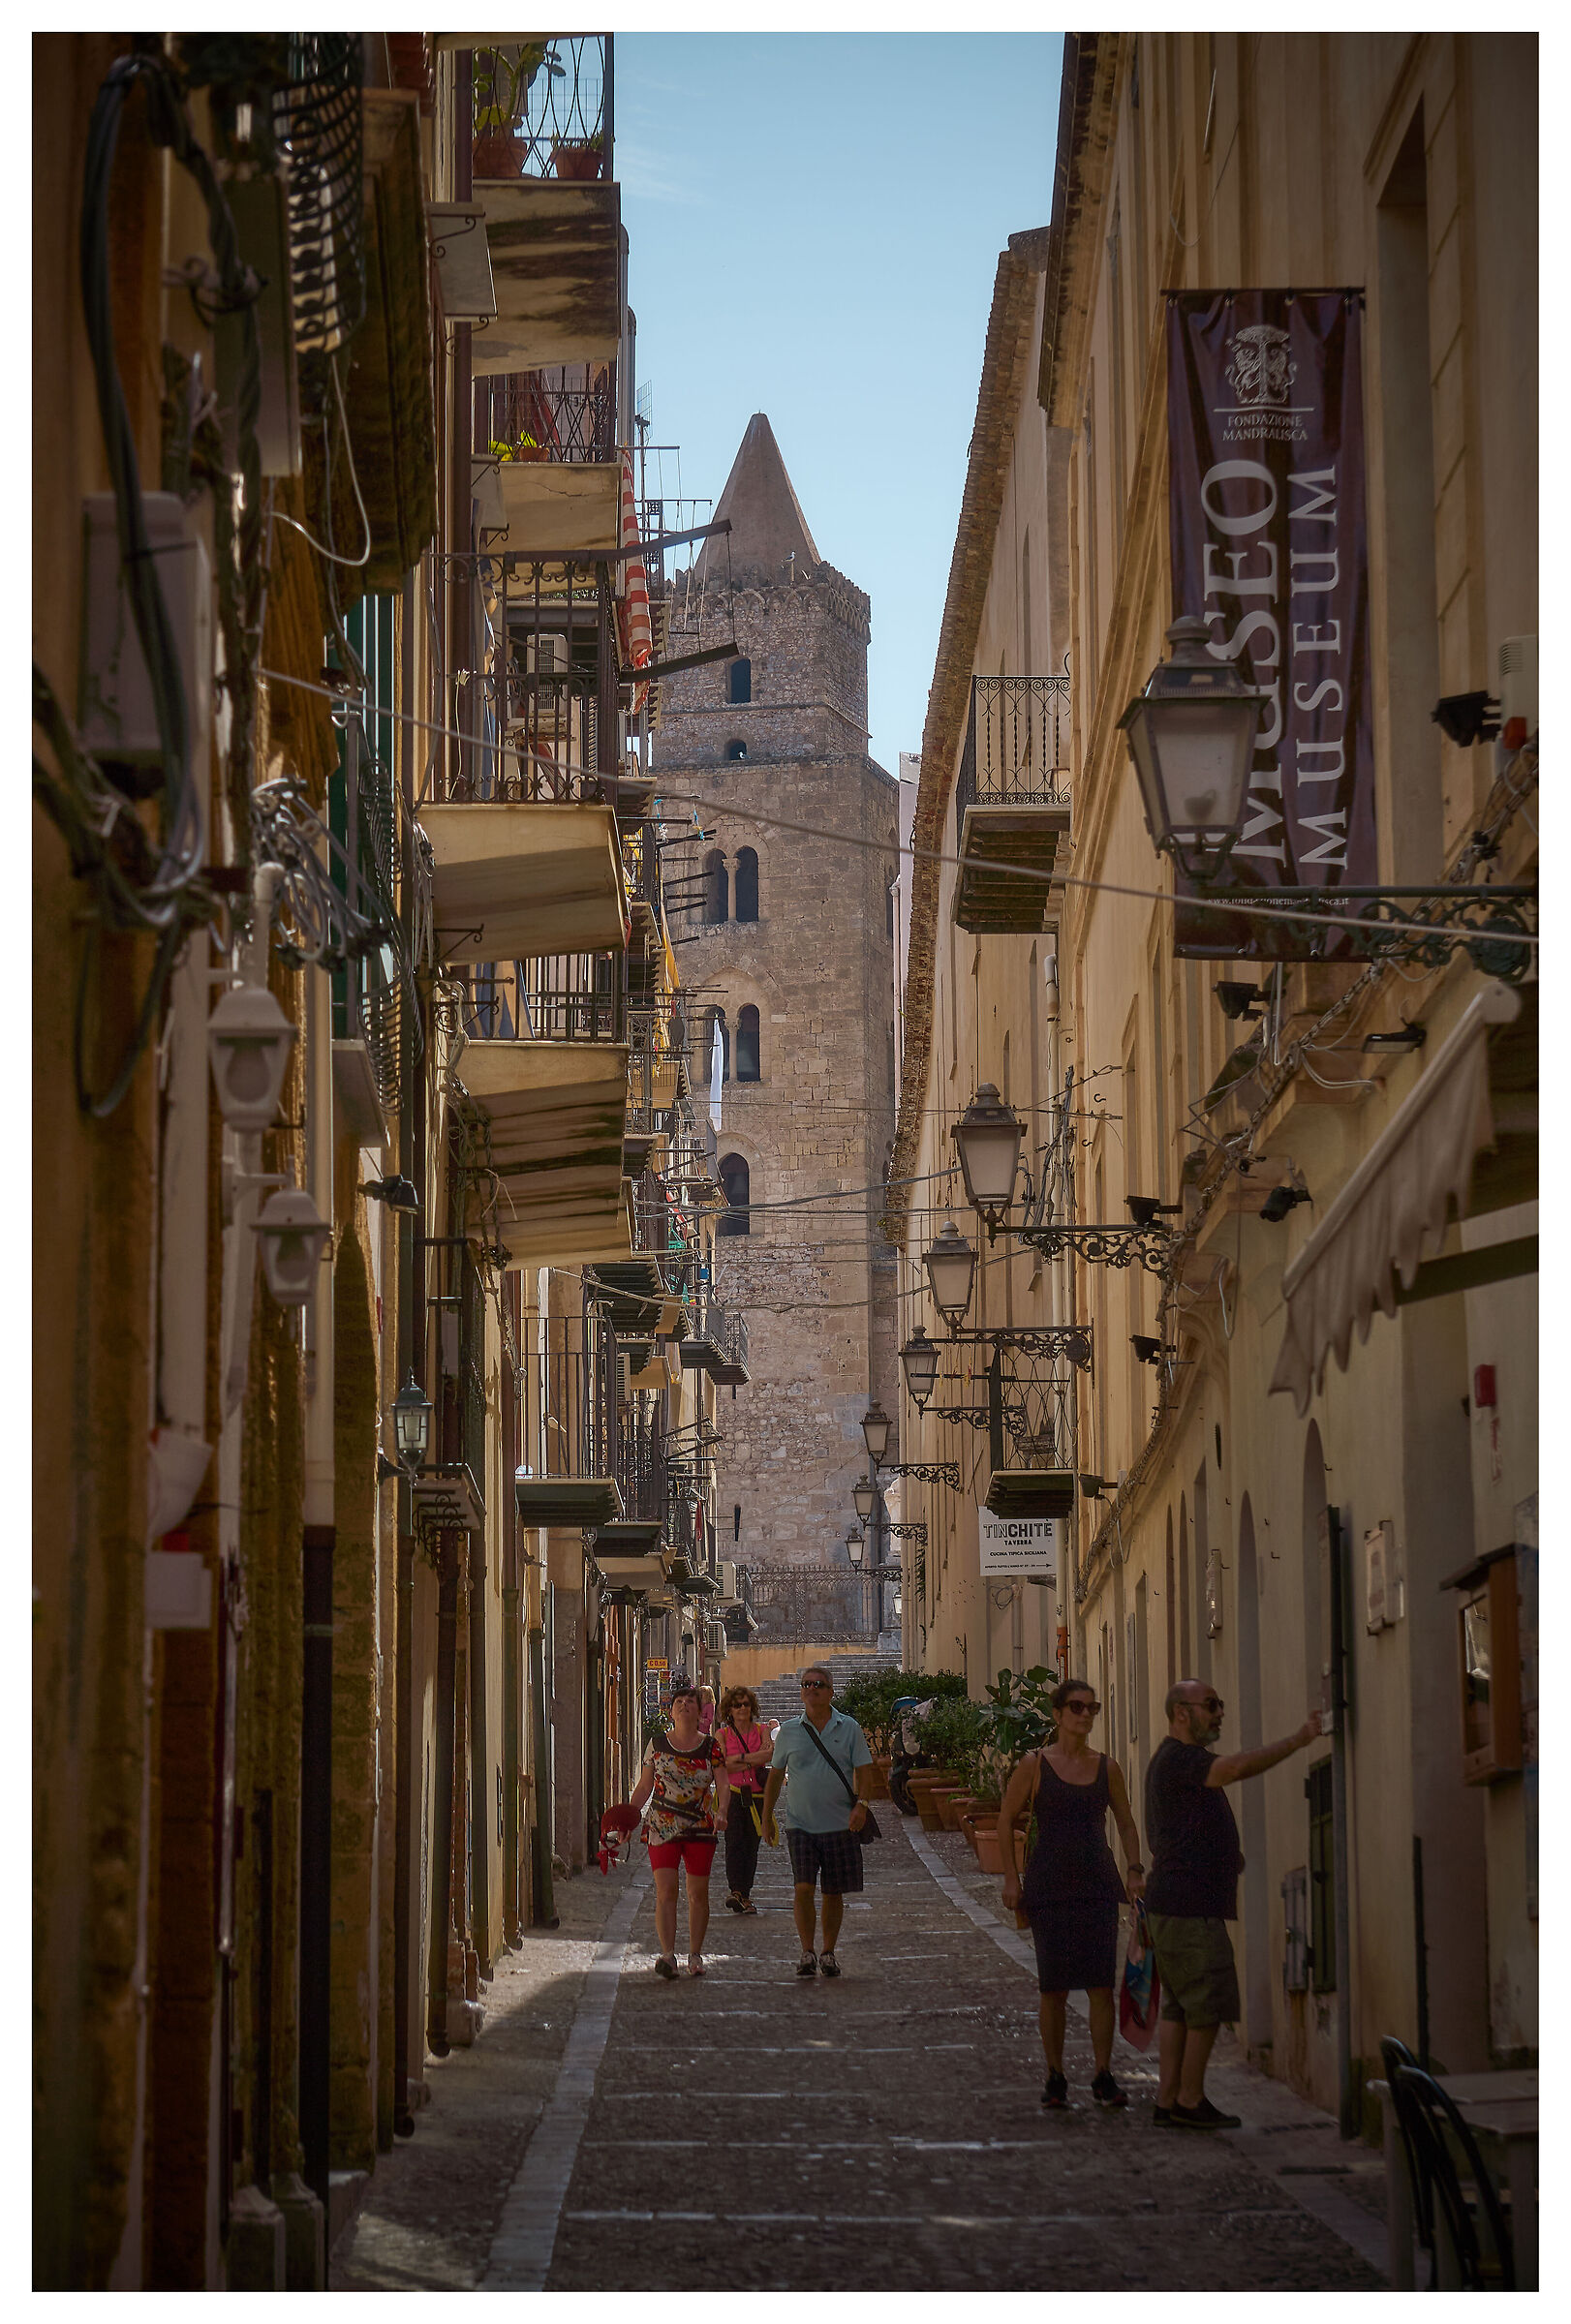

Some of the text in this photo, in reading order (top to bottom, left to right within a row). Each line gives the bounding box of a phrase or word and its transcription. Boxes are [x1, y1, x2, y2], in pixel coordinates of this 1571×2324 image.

[1227, 413, 1303, 427] FONDAZIONE
[1222, 427, 1309, 442] MANDRALISCA
[1288, 466, 1348, 870] MUSEUM
[983, 1519, 1053, 1538] TINCHITÈ
